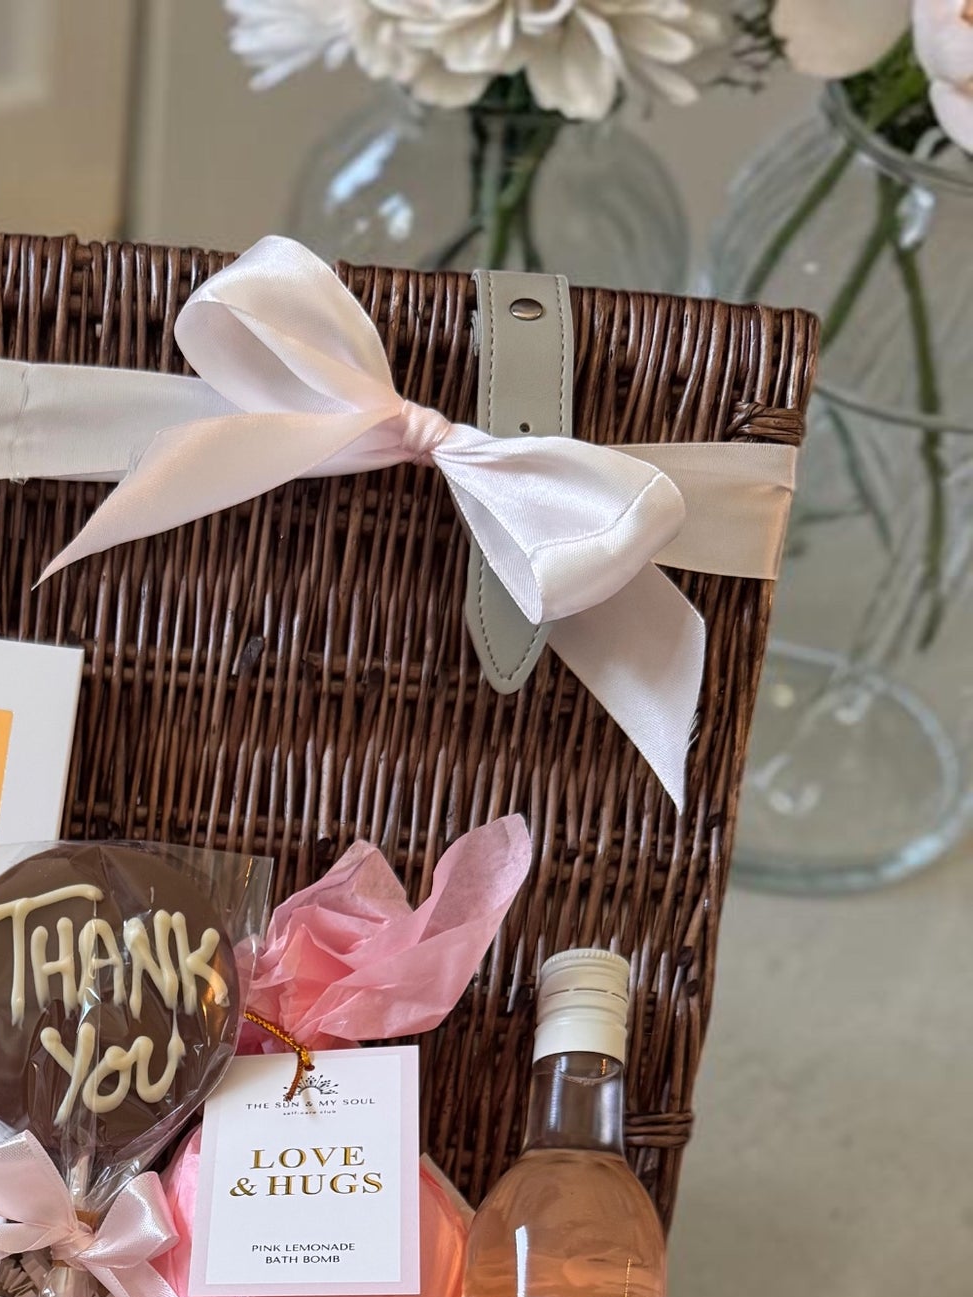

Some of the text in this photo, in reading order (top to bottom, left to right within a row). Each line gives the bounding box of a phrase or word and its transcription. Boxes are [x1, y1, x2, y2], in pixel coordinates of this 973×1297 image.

[275, 1101, 299, 1109] SUN
[319, 1099, 336, 1107] MY
[343, 1097, 376, 1105] SOUL
[250, 1146, 365, 1169] LOVE
[229, 1172, 383, 1197] & HUGS
[252, 1243, 355, 1252] PINK LEMONADE
[265, 1255, 340, 1264] BATH BOMB
